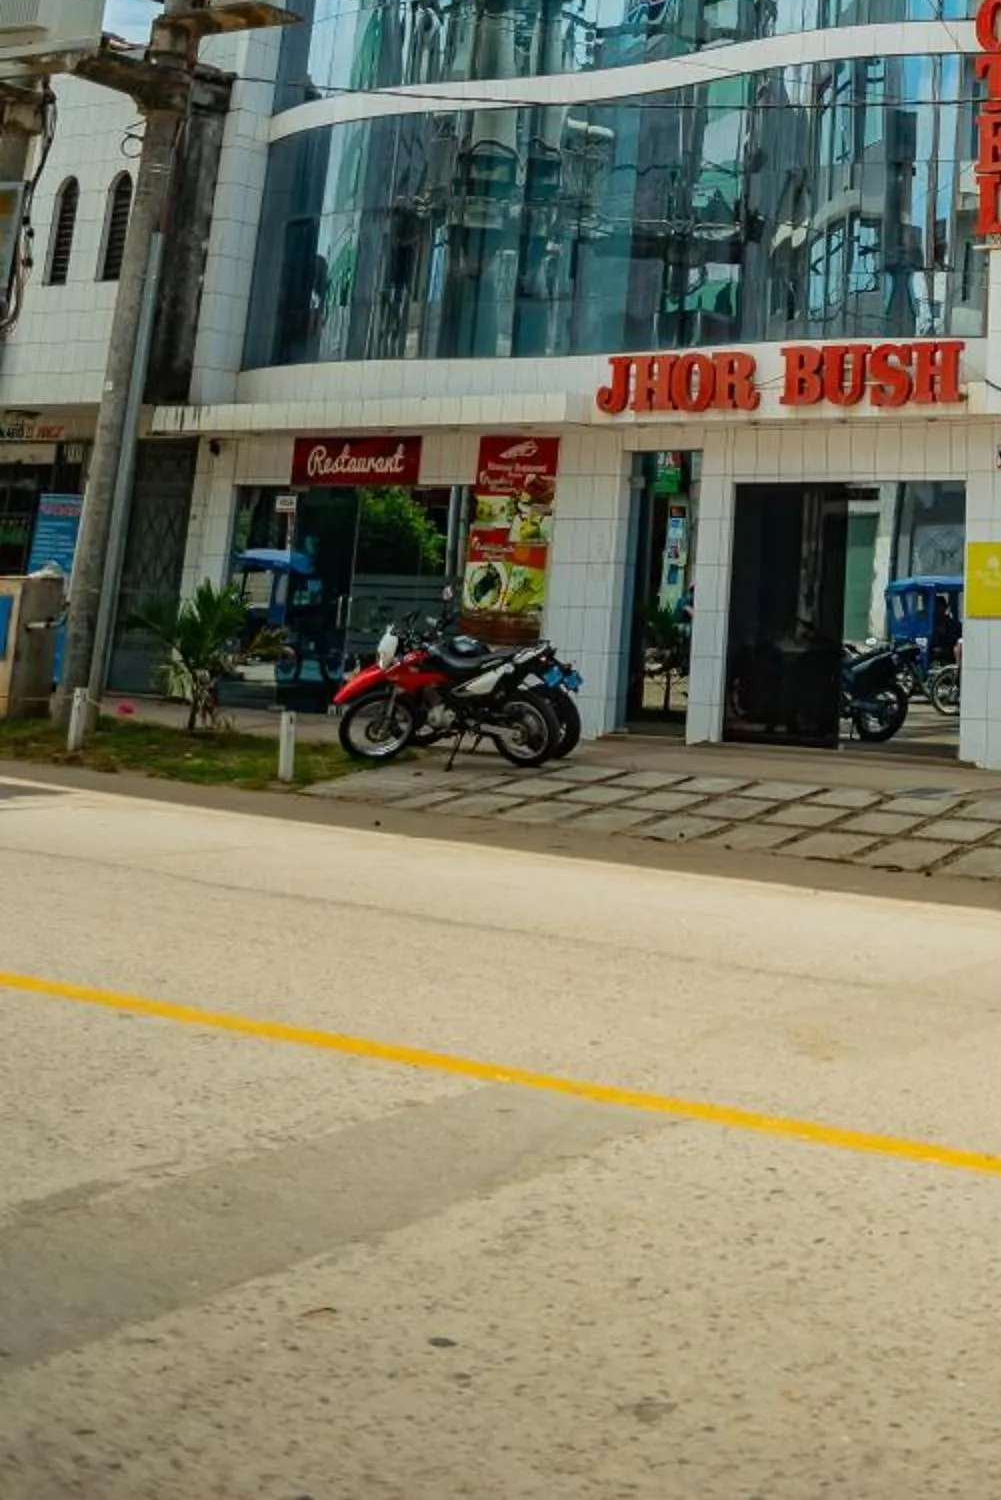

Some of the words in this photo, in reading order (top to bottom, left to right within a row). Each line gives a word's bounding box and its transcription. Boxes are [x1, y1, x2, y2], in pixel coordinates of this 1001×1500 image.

[595, 351, 761, 414] JHOR
[779, 340, 967, 407] BUSH
[307, 443, 405, 477] Restaurant
